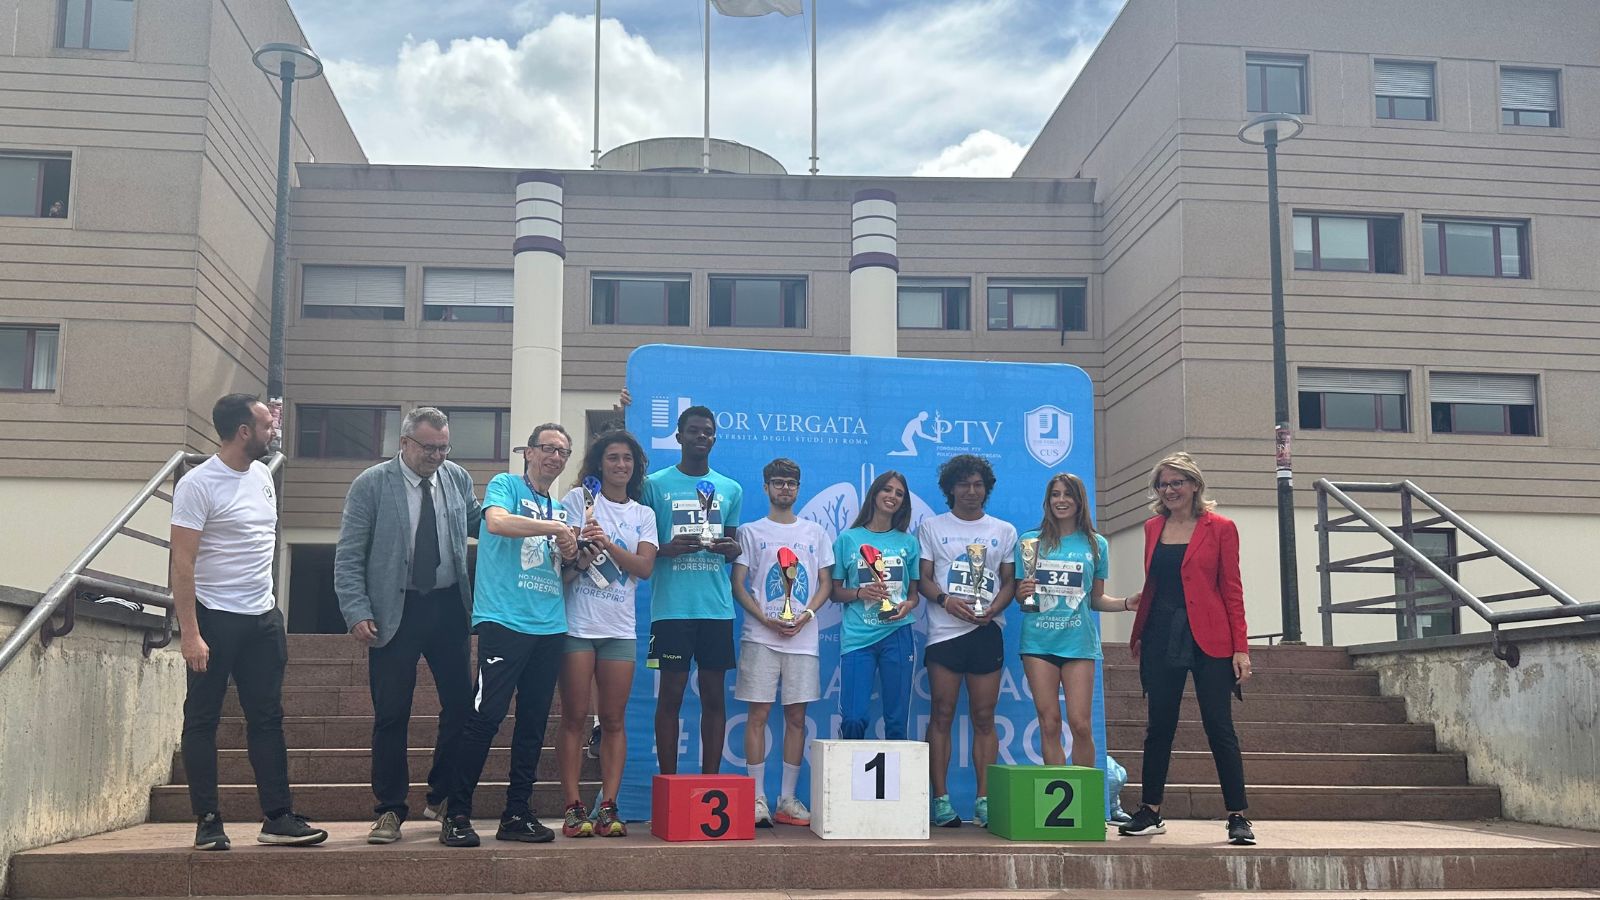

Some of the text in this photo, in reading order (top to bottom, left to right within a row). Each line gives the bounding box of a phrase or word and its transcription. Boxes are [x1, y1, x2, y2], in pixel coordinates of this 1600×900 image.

[713, 411, 868, 435] OR VERGATA
[934, 419, 1003, 445] PTV
[1040, 448, 1059, 457] CUS
[673, 562, 720, 572] #IORESPIRO
[1048, 571, 1069, 585] 34
[865, 752, 886, 800] 1
[700, 789, 730, 838] 3
[1044, 780, 1075, 828] 2
